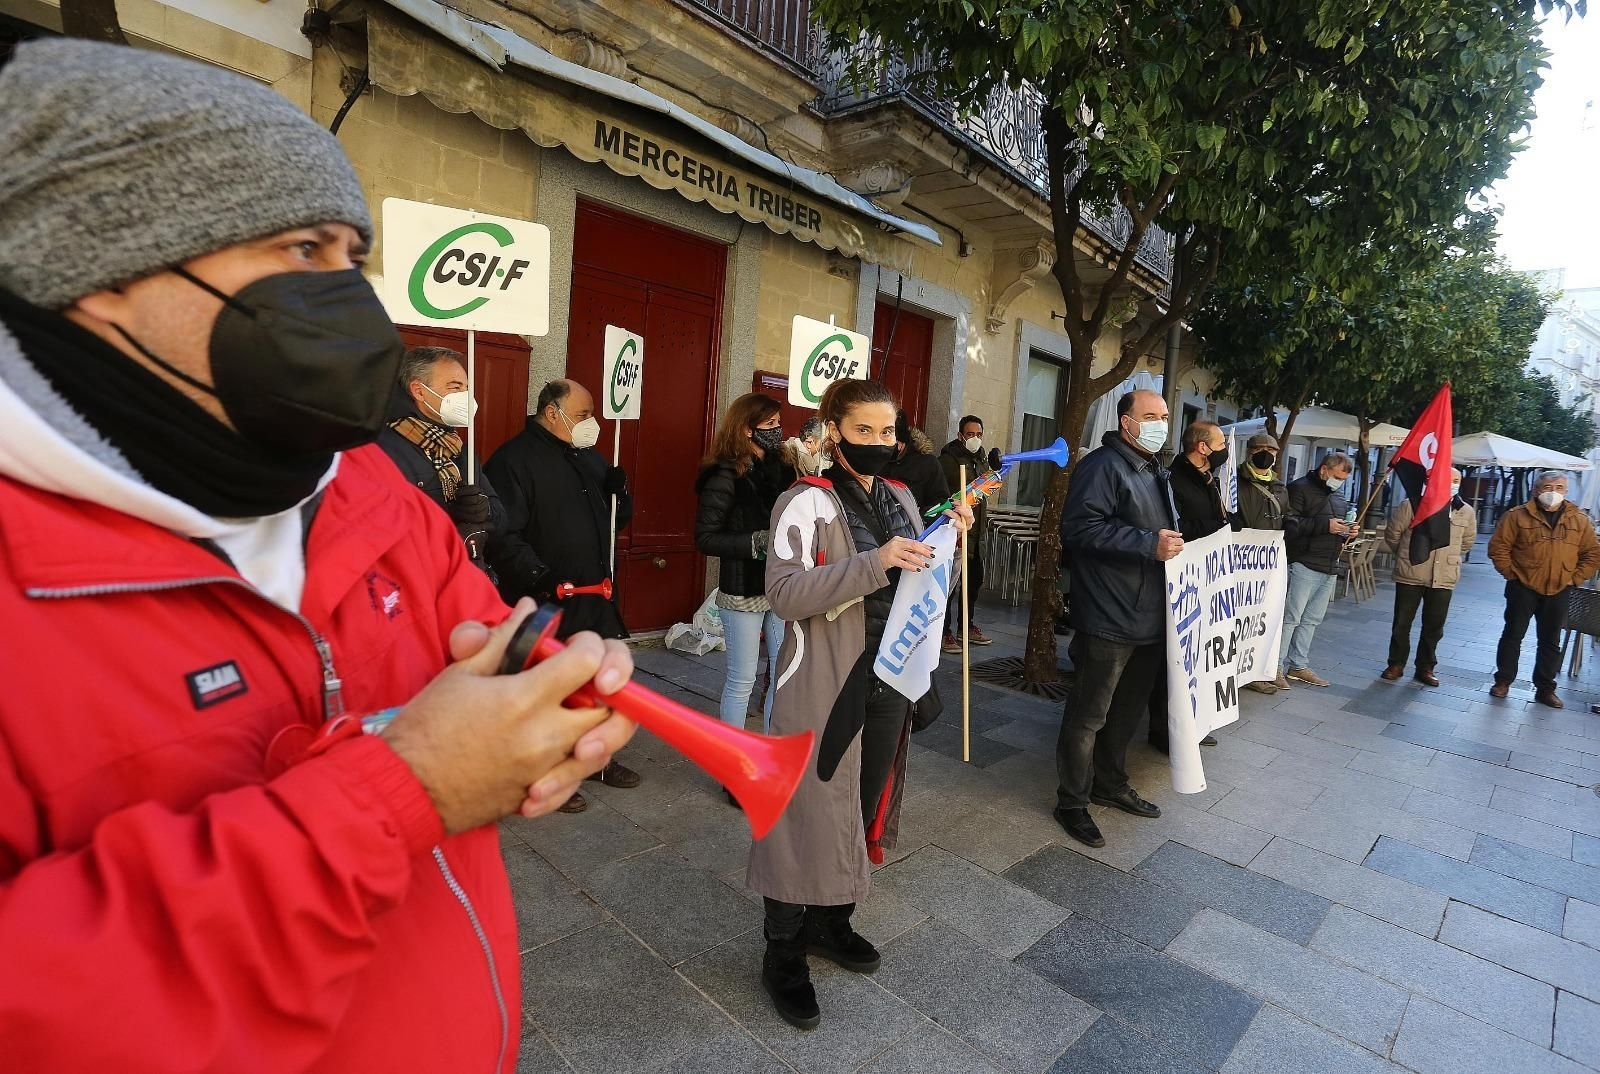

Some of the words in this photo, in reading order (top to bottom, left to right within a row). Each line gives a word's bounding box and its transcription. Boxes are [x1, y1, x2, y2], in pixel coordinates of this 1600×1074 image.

[594, 119, 740, 202] MERCERIA
[746, 182, 822, 233] TRIBER
[1205, 550, 1218, 587] NO
